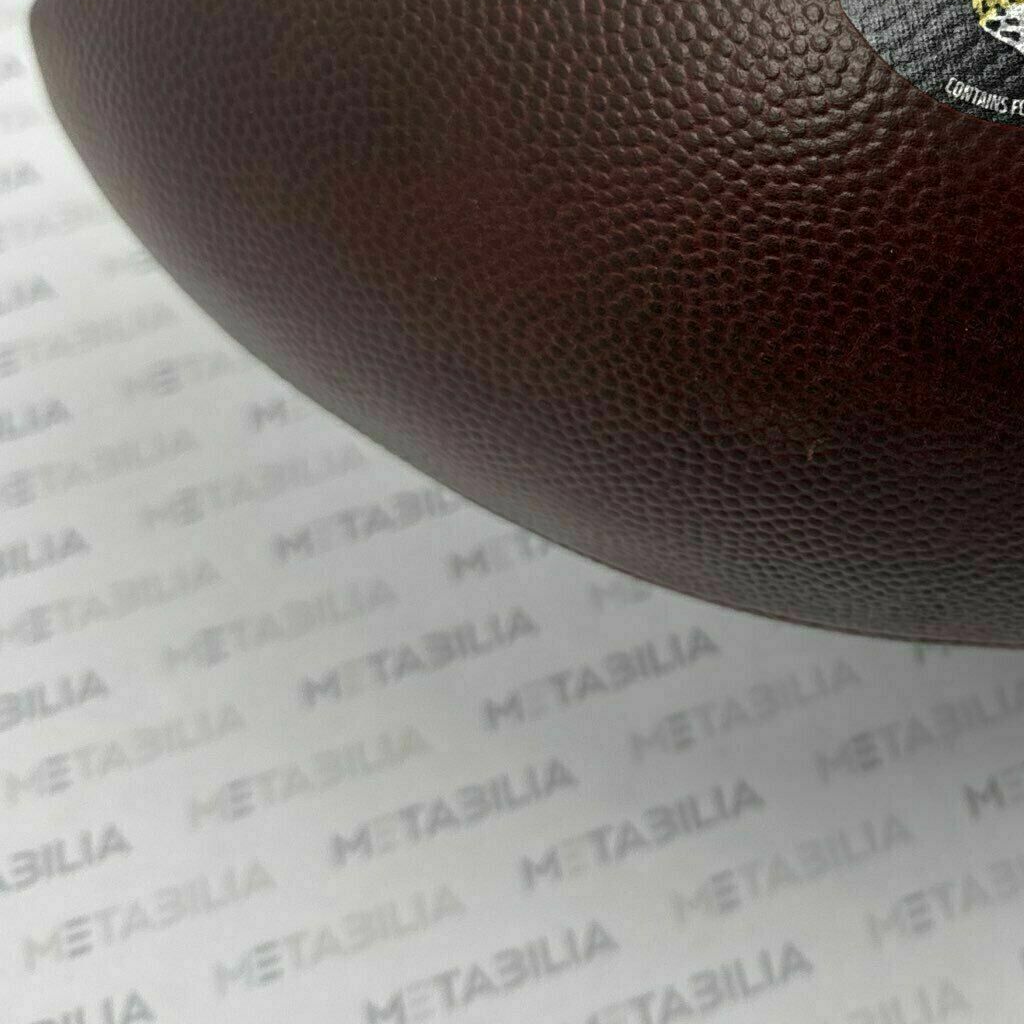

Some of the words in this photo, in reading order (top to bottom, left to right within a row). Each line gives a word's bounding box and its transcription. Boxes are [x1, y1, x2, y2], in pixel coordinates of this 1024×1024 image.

[945, 77, 1008, 114] CONTAINS
[330, 757, 580, 867] METABILIA
[519, 778, 765, 894] METABILIA
